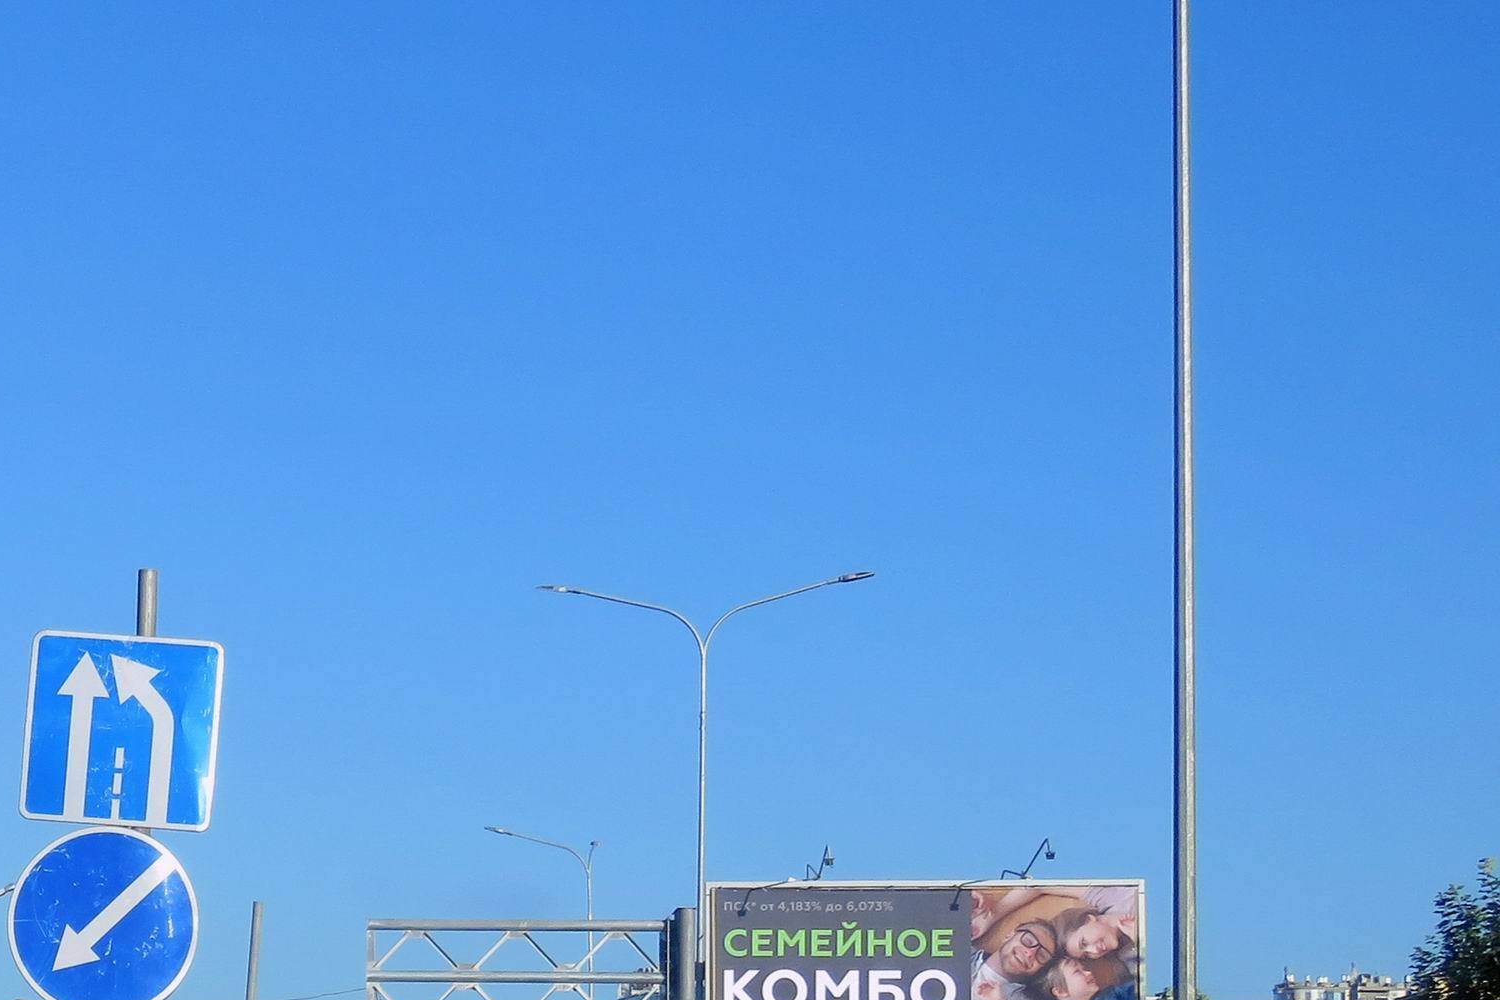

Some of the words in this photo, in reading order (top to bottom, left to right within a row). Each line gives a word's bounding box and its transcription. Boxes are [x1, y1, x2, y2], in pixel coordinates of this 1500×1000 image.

[760, 903, 774, 912] от
[777, 901, 822, 914] 4,183%
[825, 903, 842, 912] до
[846, 901, 894, 913] 6,073%
[723, 921, 954, 957] СЕМЕЙНОЕ
